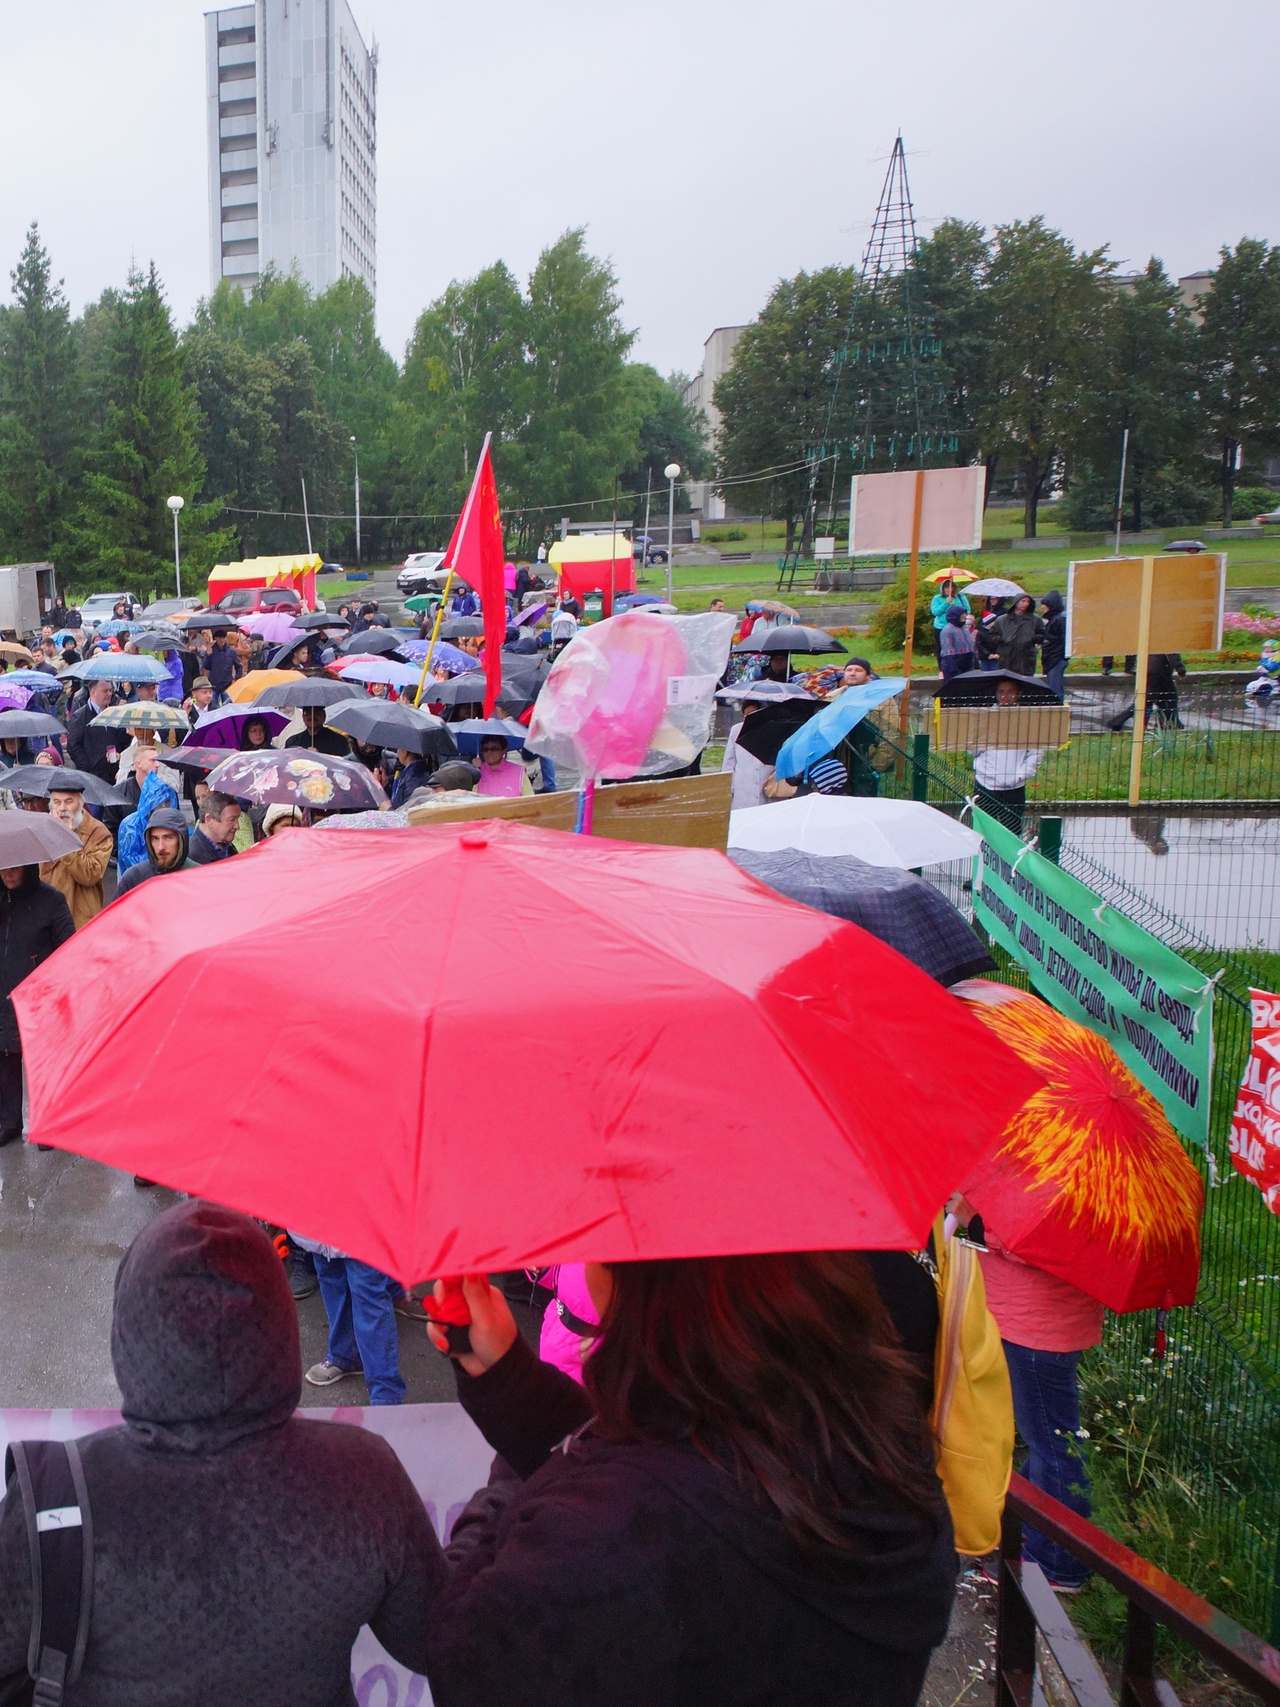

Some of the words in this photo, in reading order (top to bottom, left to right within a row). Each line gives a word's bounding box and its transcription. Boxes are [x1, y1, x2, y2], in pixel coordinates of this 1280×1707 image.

[1046, 894, 1108, 971] СТРОИТЕЛЬСТВО
[1109, 946, 1144, 1000] ЖИЛЬЯ
[1140, 974, 1157, 1014] ДО
[1158, 987, 1195, 1046] ВВОДА
[1046, 945, 1082, 999] ДЕТСКИХ
[1079, 976, 1108, 1025] САДОВ
[1108, 1001, 1120, 1034] И
